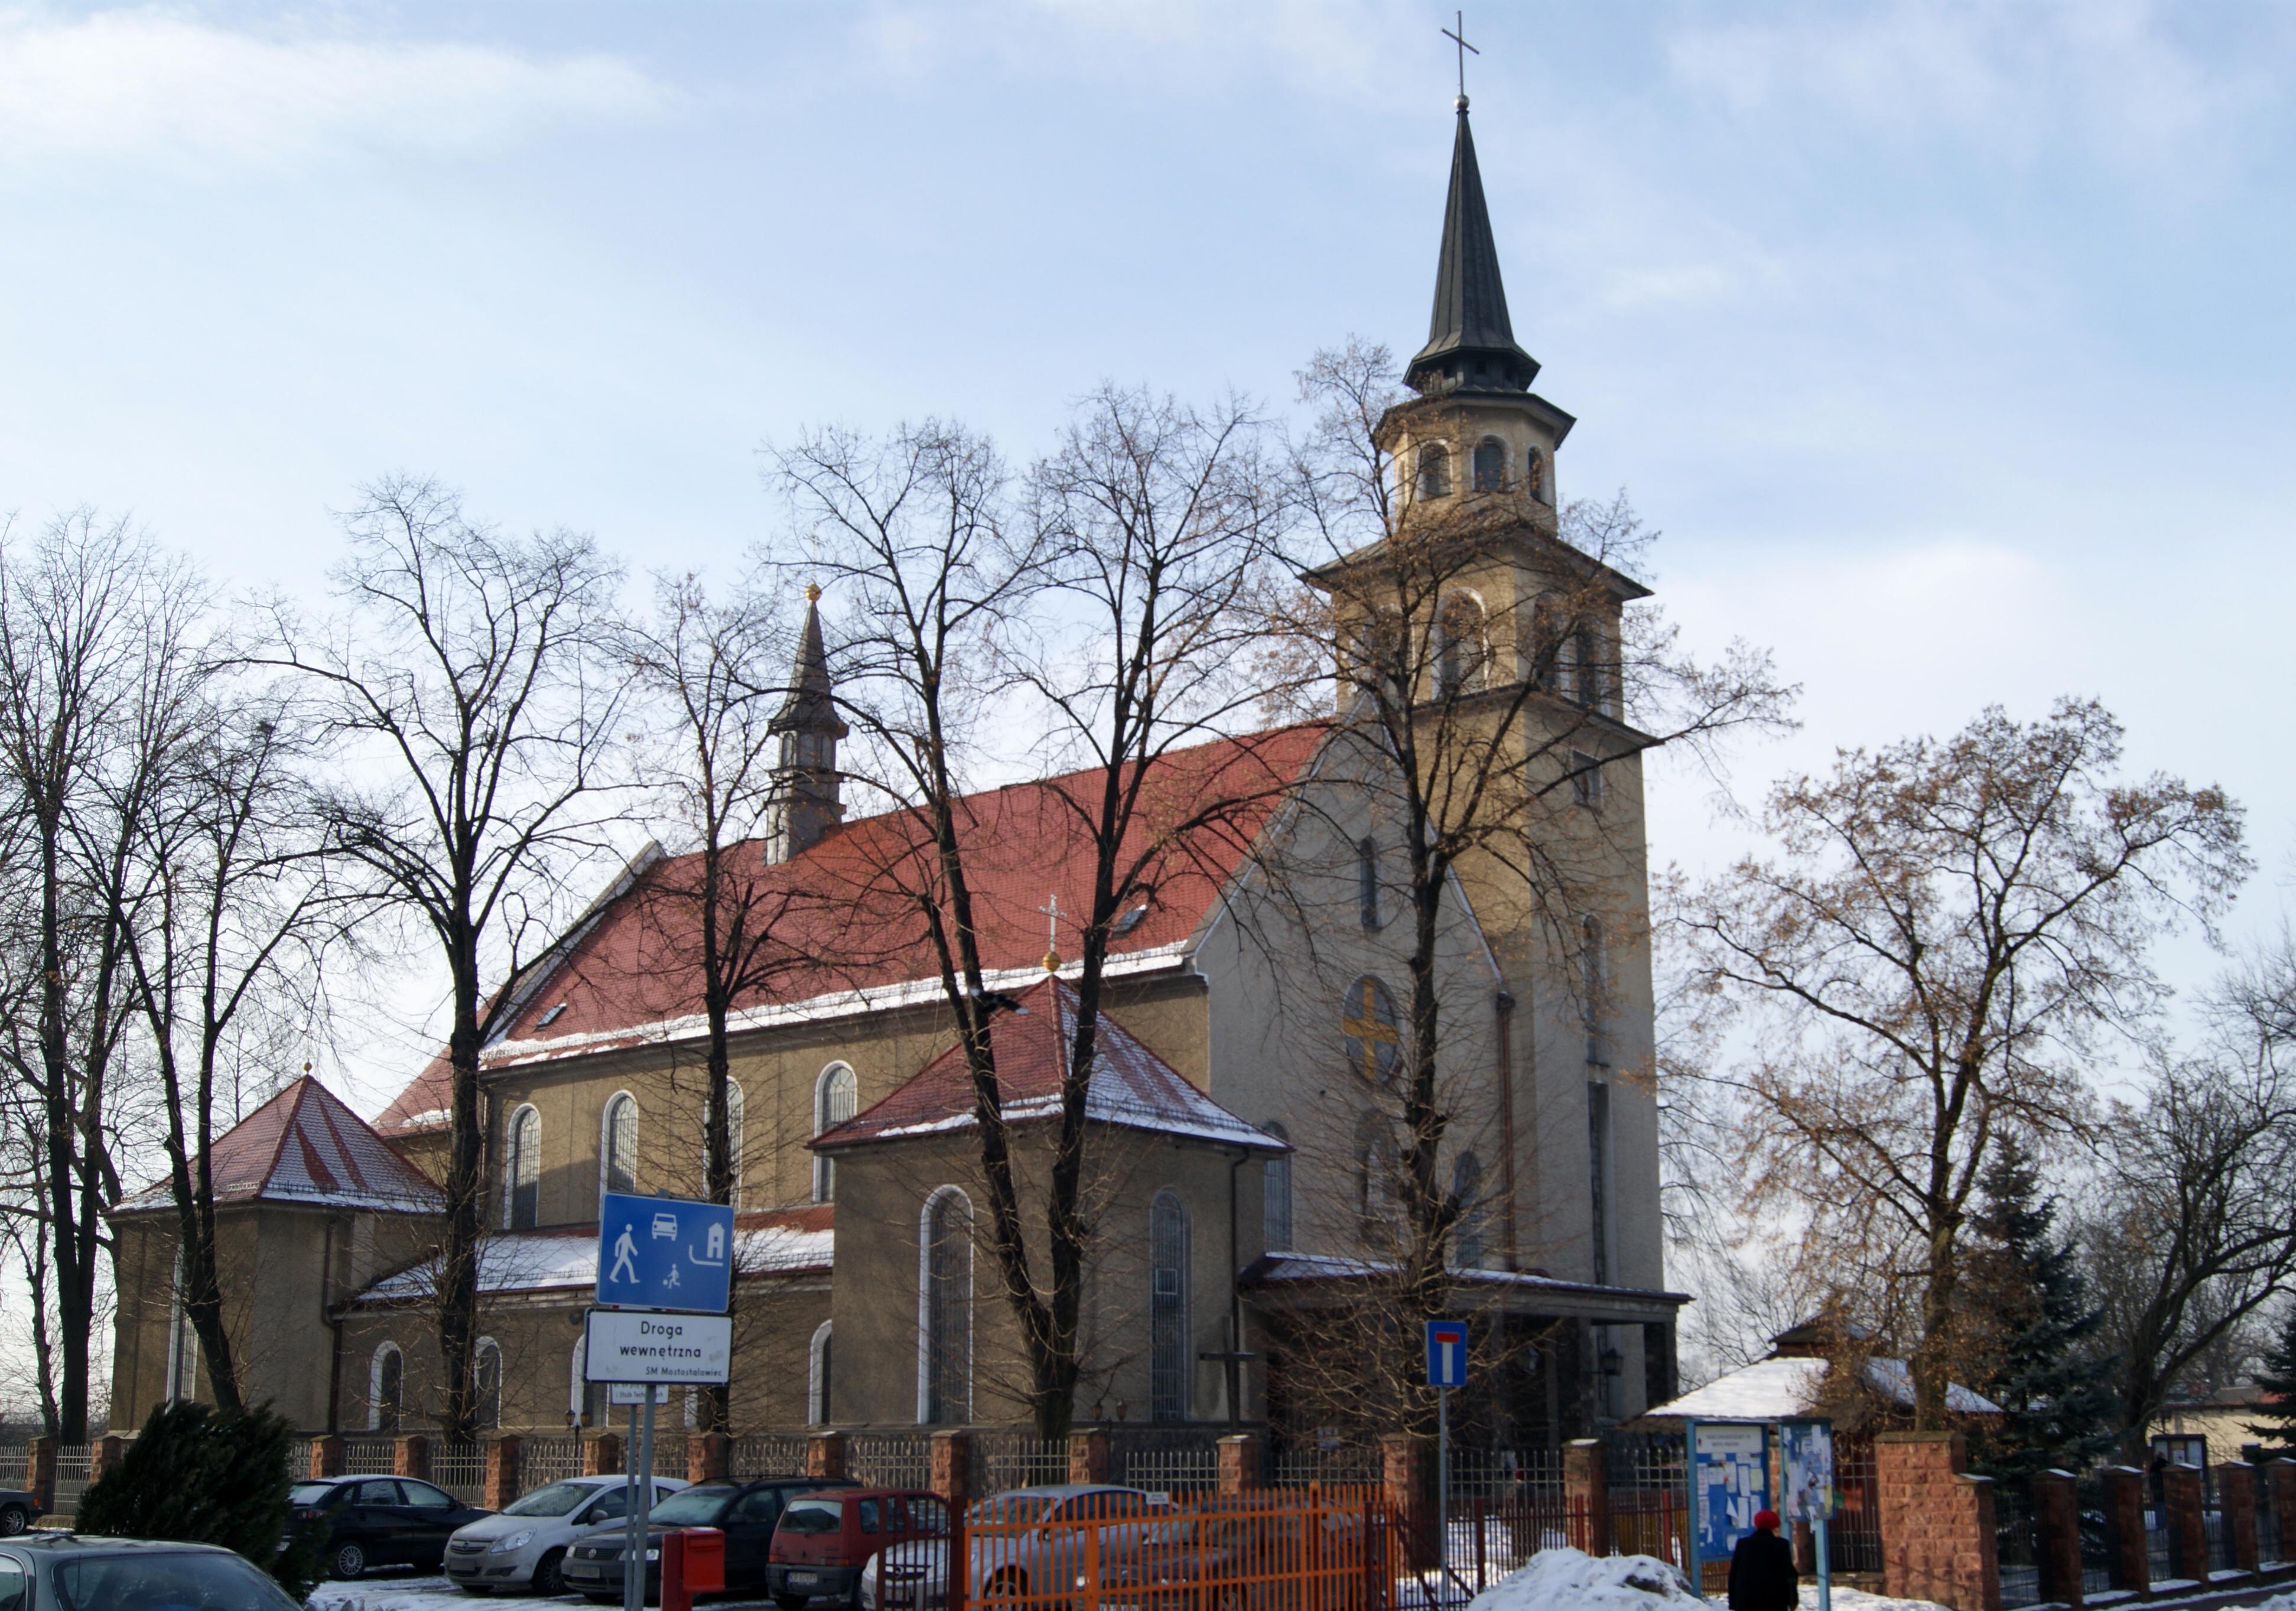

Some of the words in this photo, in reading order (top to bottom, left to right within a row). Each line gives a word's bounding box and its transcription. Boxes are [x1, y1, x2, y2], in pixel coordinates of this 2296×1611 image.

[641, 1321, 682, 1339] Droga
[620, 1345, 701, 1360] wewnętrzna
[646, 1366, 658, 1375] SM
[661, 1366, 722, 1376] Mostostalowiec
